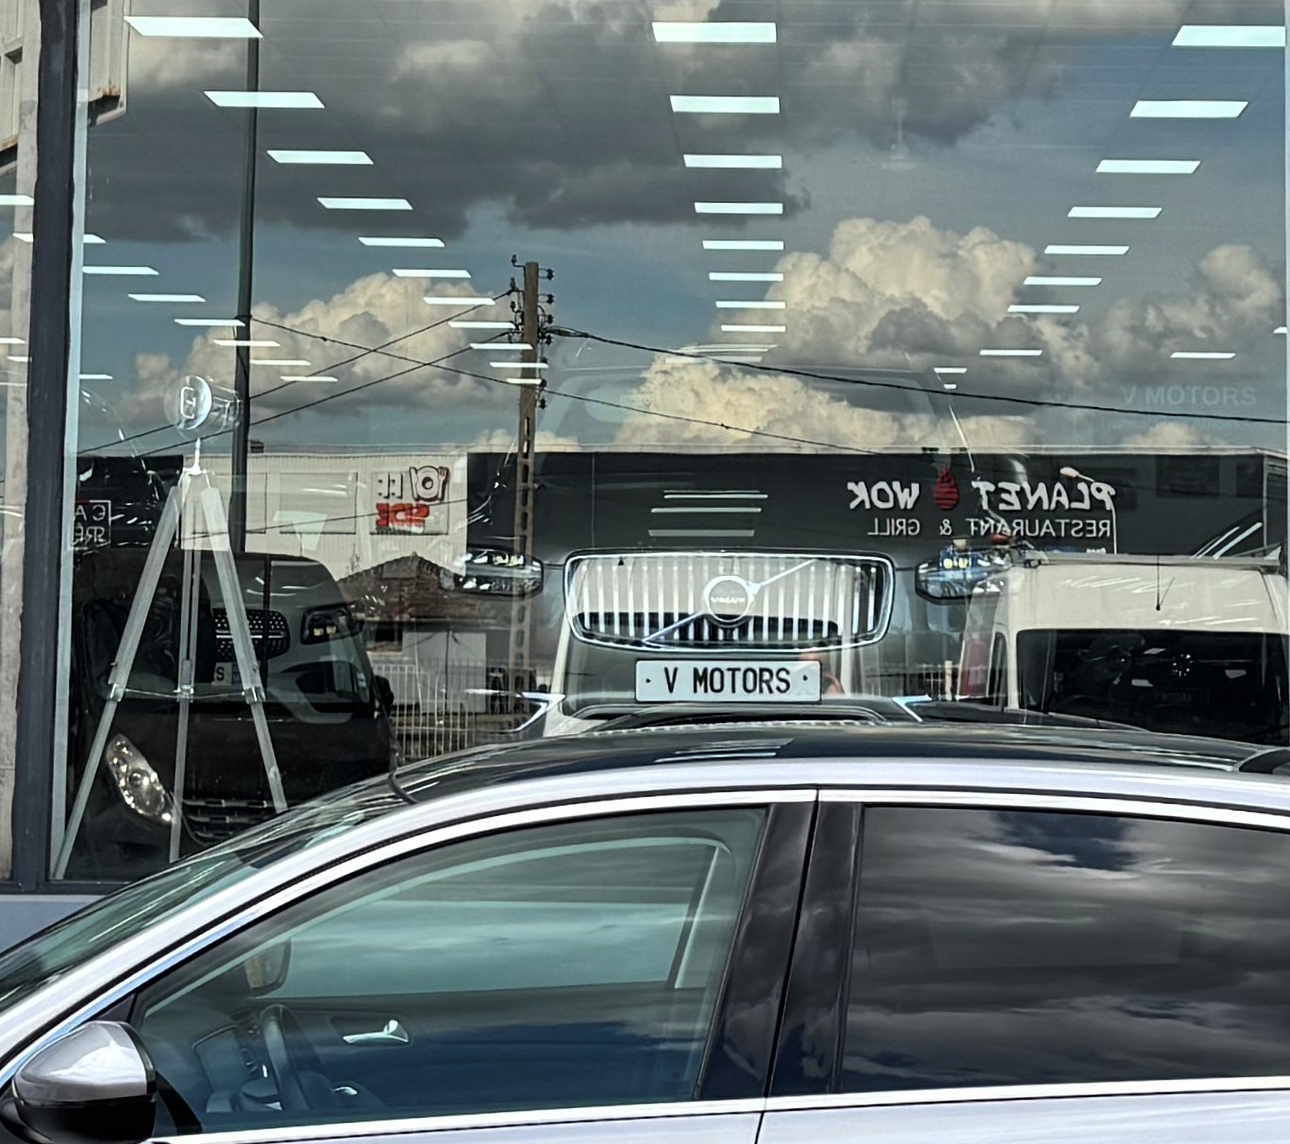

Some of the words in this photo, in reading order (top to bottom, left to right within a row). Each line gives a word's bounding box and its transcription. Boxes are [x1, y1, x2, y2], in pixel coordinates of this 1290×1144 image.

[1145, 385, 1257, 406] MOTORS
[664, 667, 678, 694] V
[693, 667, 791, 694] MOTORS
